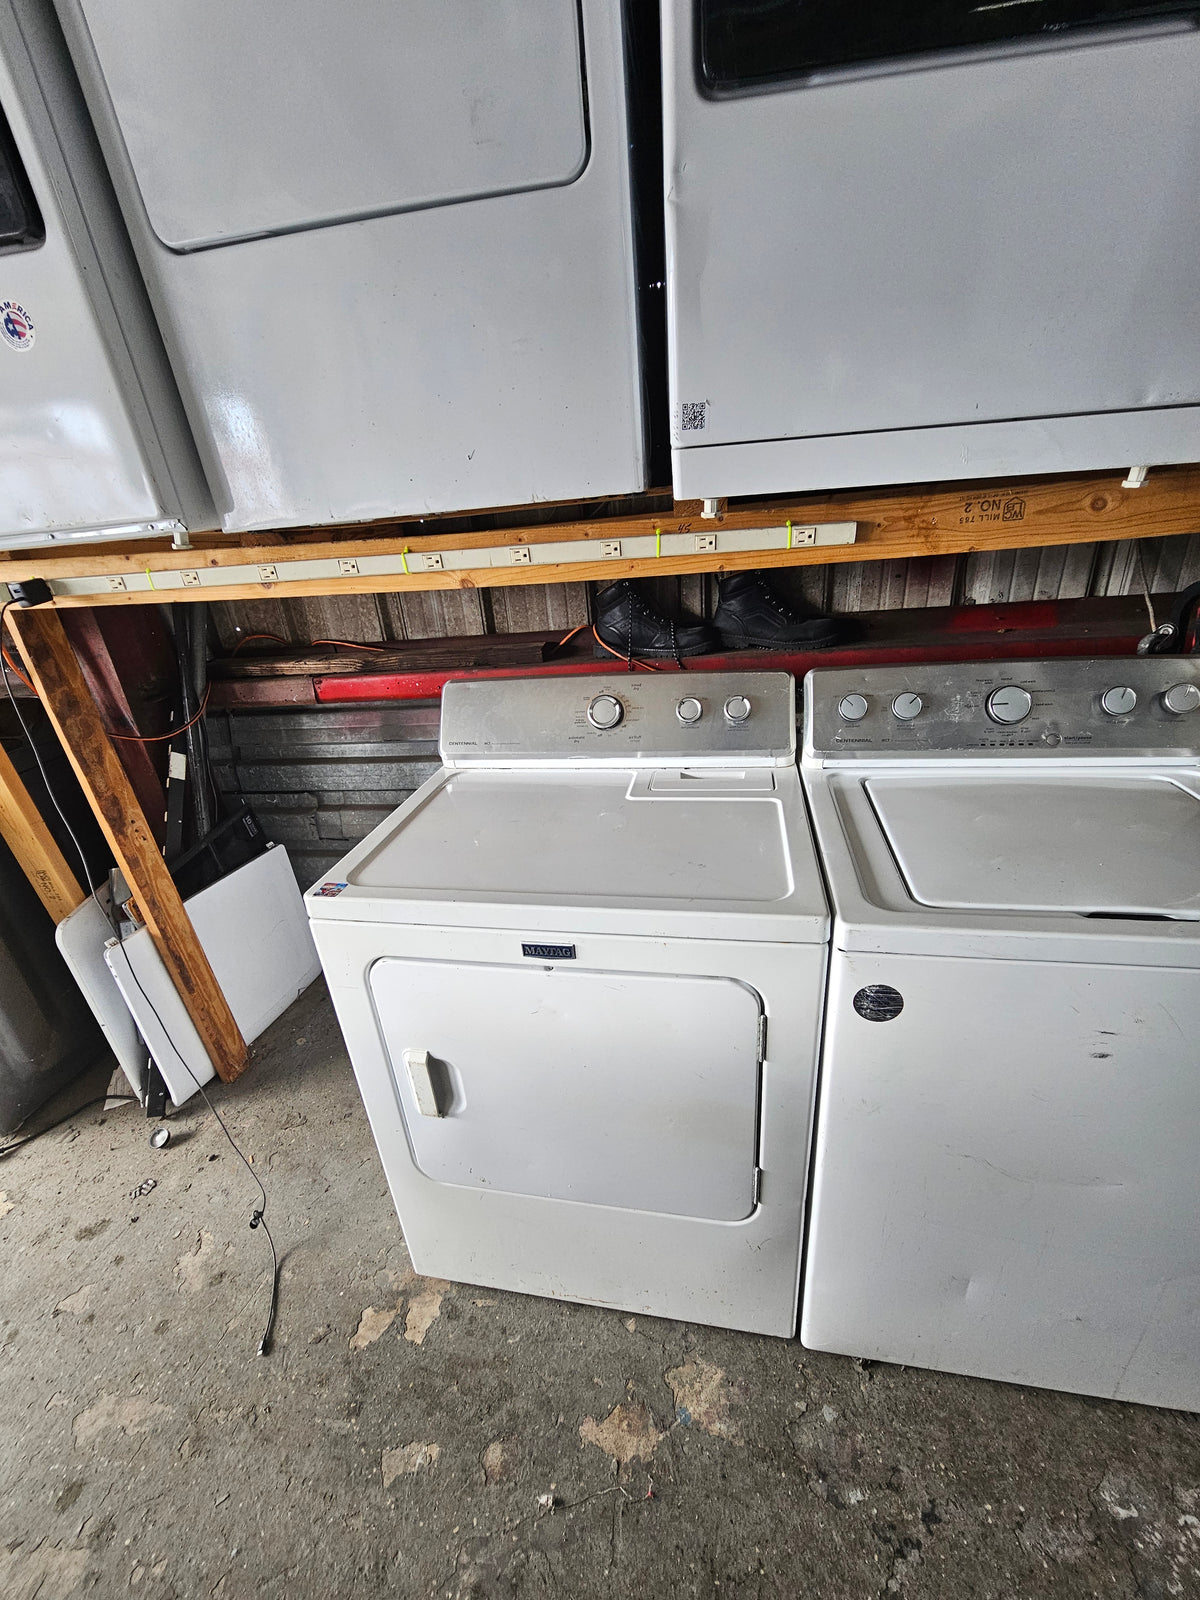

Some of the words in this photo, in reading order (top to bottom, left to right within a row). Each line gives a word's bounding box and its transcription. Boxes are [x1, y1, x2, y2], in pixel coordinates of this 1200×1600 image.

[0, 301, 34, 331] AMERICA
[964, 502, 973, 514] 2
[524, 946, 571, 957] MAYTAG
